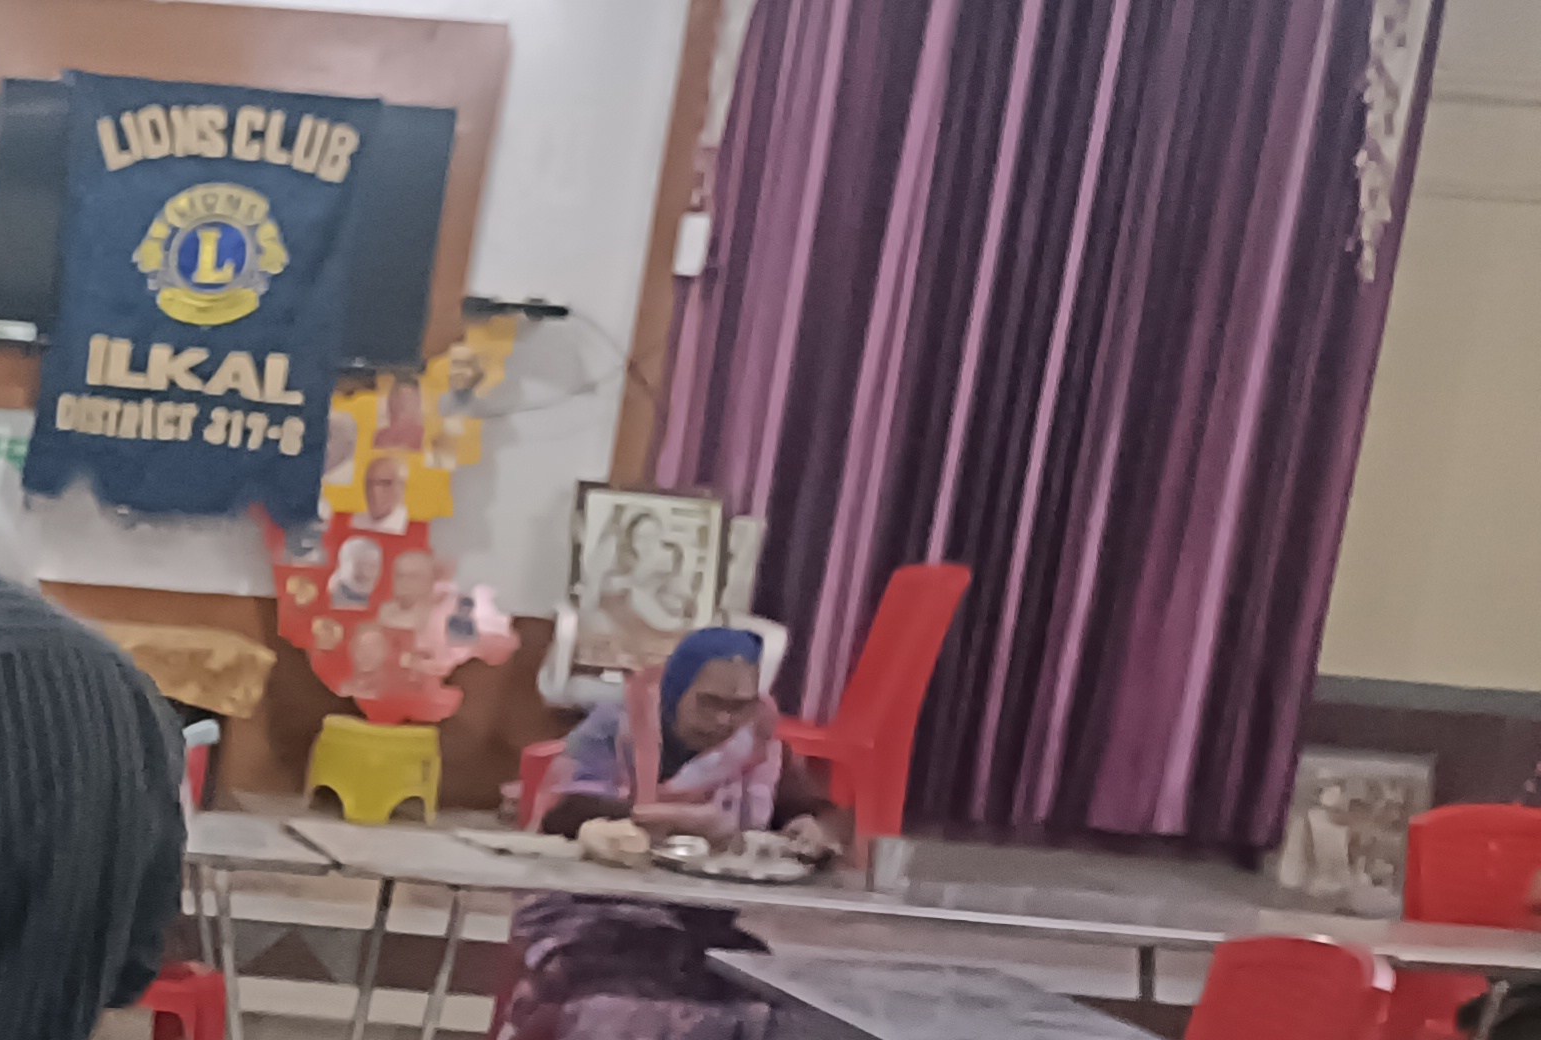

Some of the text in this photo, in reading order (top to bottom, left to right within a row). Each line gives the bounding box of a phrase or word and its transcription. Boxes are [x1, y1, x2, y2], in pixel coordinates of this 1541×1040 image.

[97, 104, 360, 183] LIONS CLUB
[193, 229, 235, 283] L
[85, 333, 304, 405] ILKAL
[55, 393, 199, 441] DISTRICT
